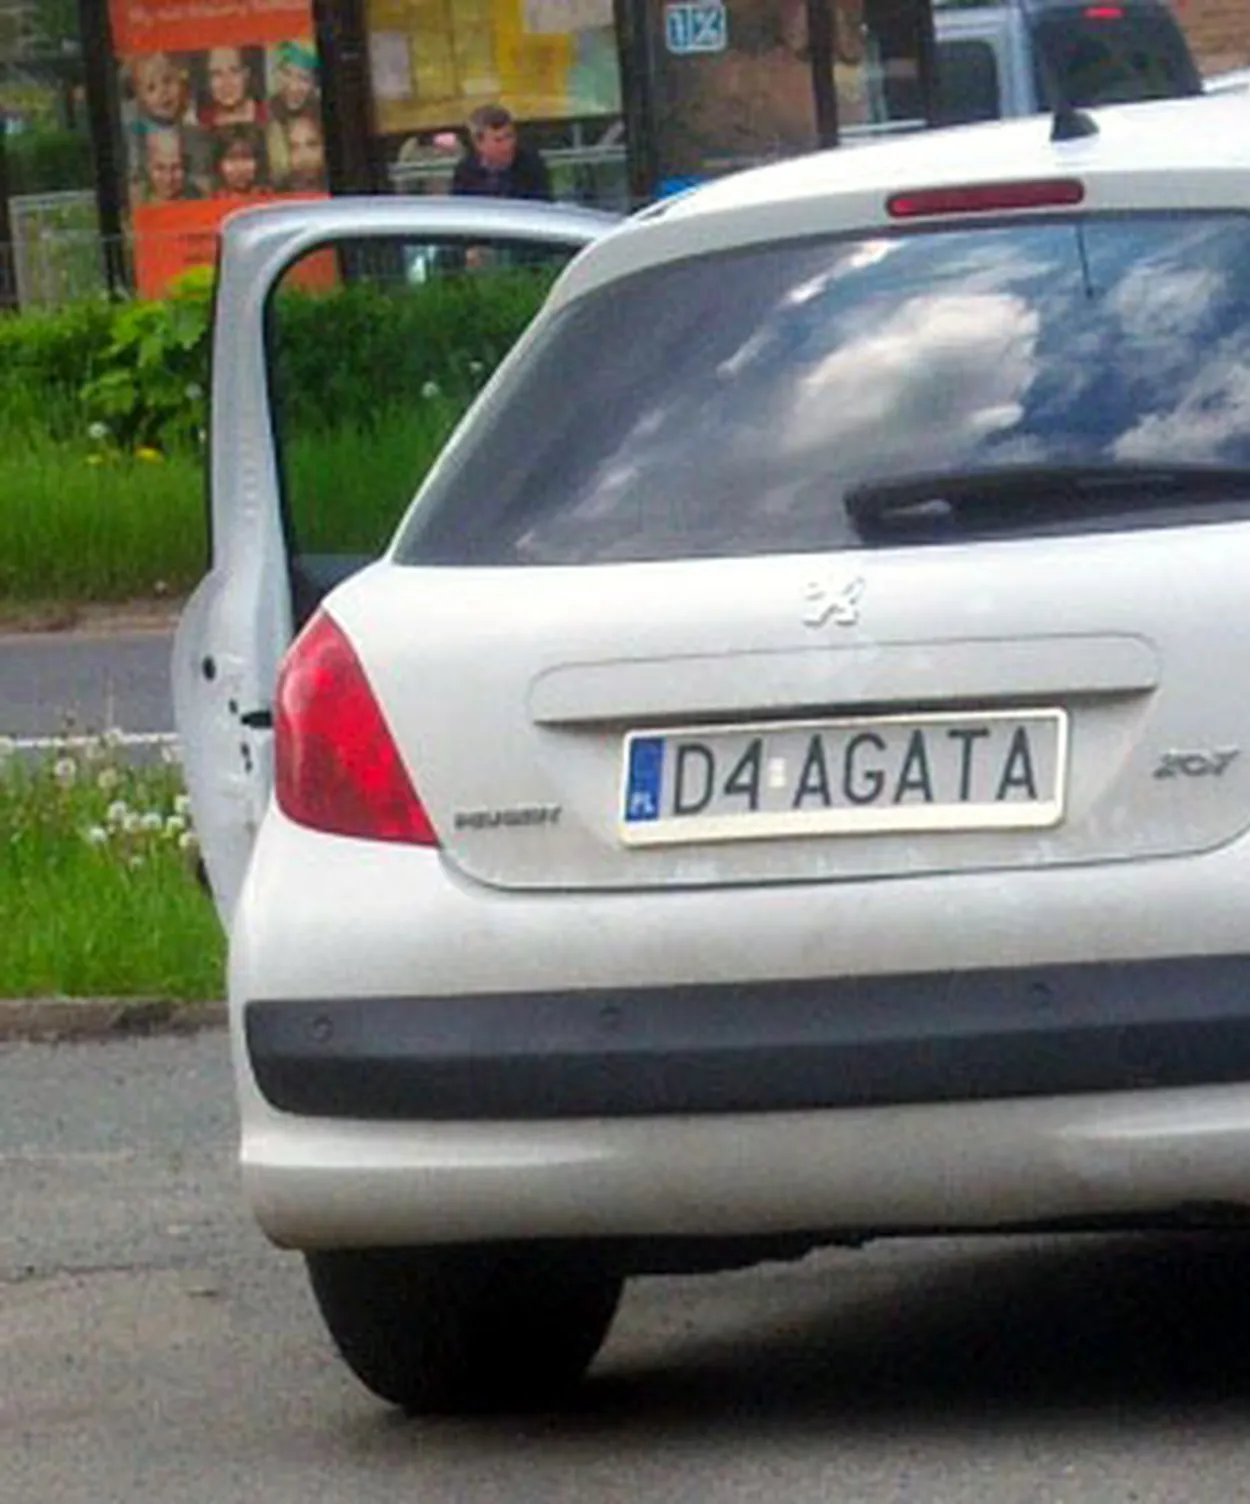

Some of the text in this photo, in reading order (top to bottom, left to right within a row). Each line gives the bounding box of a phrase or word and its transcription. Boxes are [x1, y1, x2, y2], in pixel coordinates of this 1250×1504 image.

[673, 726, 1037, 816] D4 AGATA
[1152, 748, 1240, 781] 207
